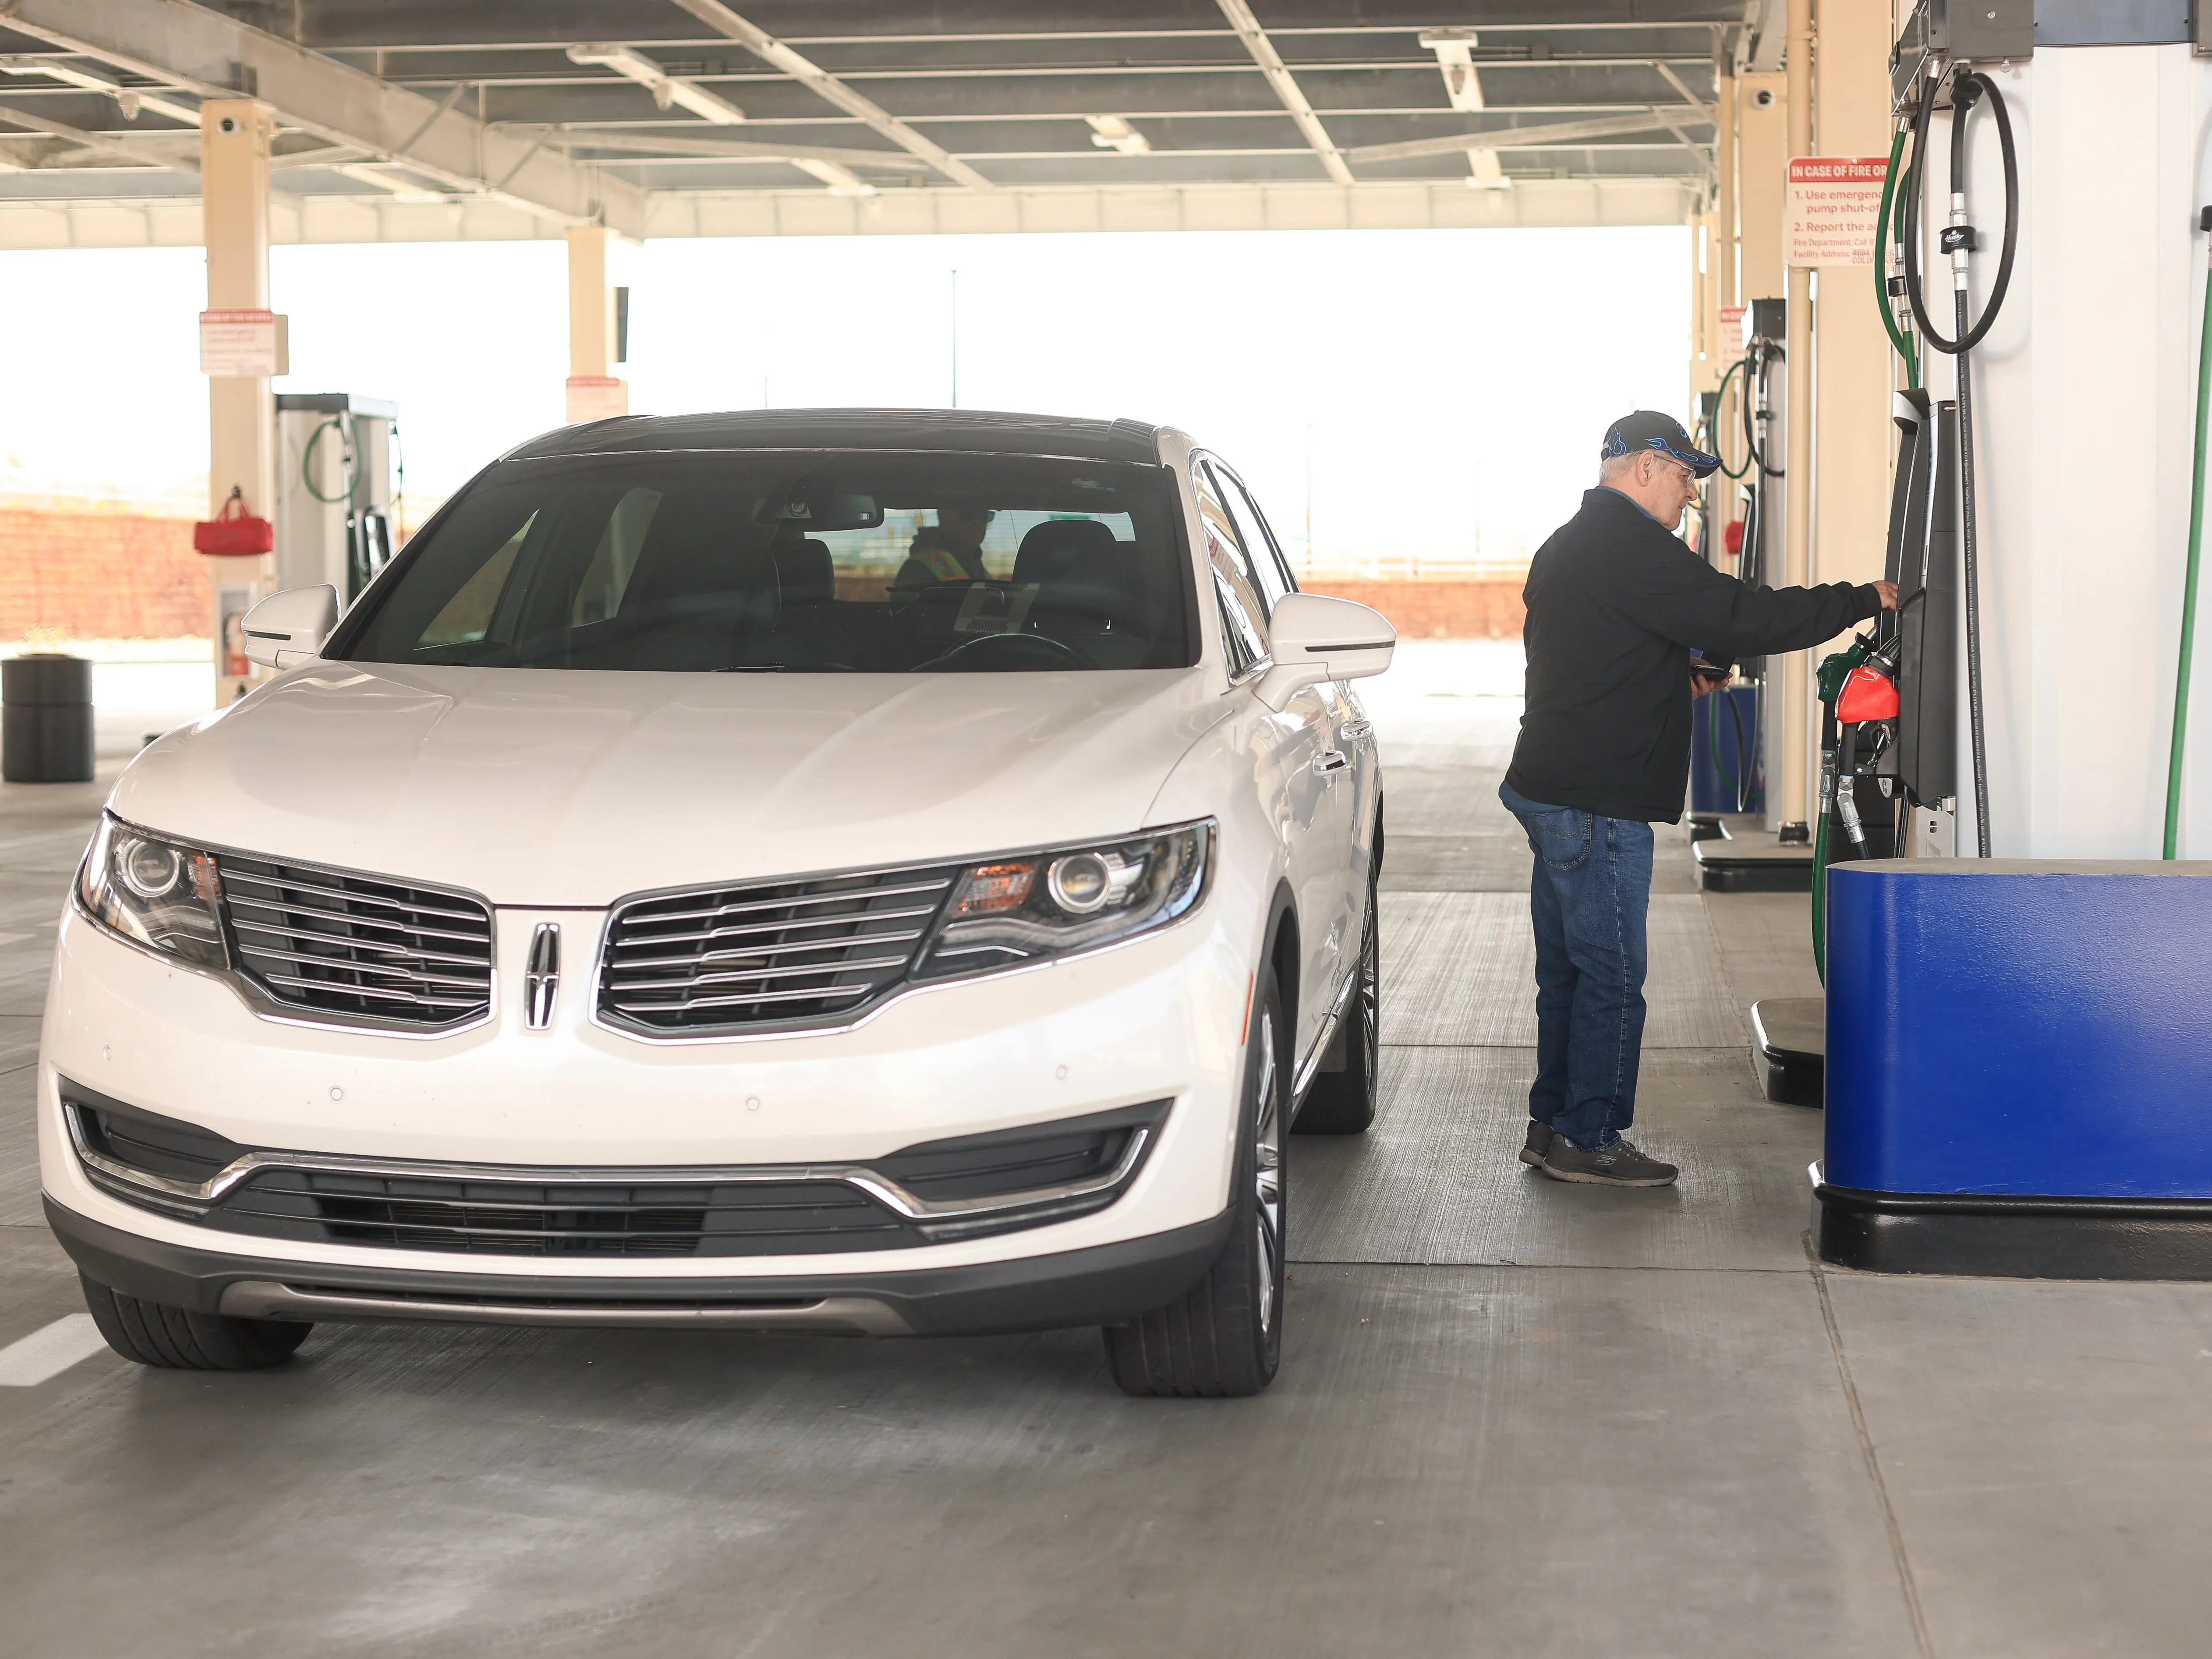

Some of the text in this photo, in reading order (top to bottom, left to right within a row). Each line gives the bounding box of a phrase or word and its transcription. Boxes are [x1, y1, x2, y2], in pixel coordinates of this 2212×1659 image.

[1791, 165, 1887, 177] IN CASE OF FIRE OR
[1794, 191, 1803, 199] 1.
[1806, 190, 1827, 199] Use
[1807, 205, 1837, 215] pump
[1794, 223, 1804, 231] 2.
[1806, 223, 1844, 233] Report
[1847, 223, 1864, 231] the
[1794, 250, 1818, 259] Facility
